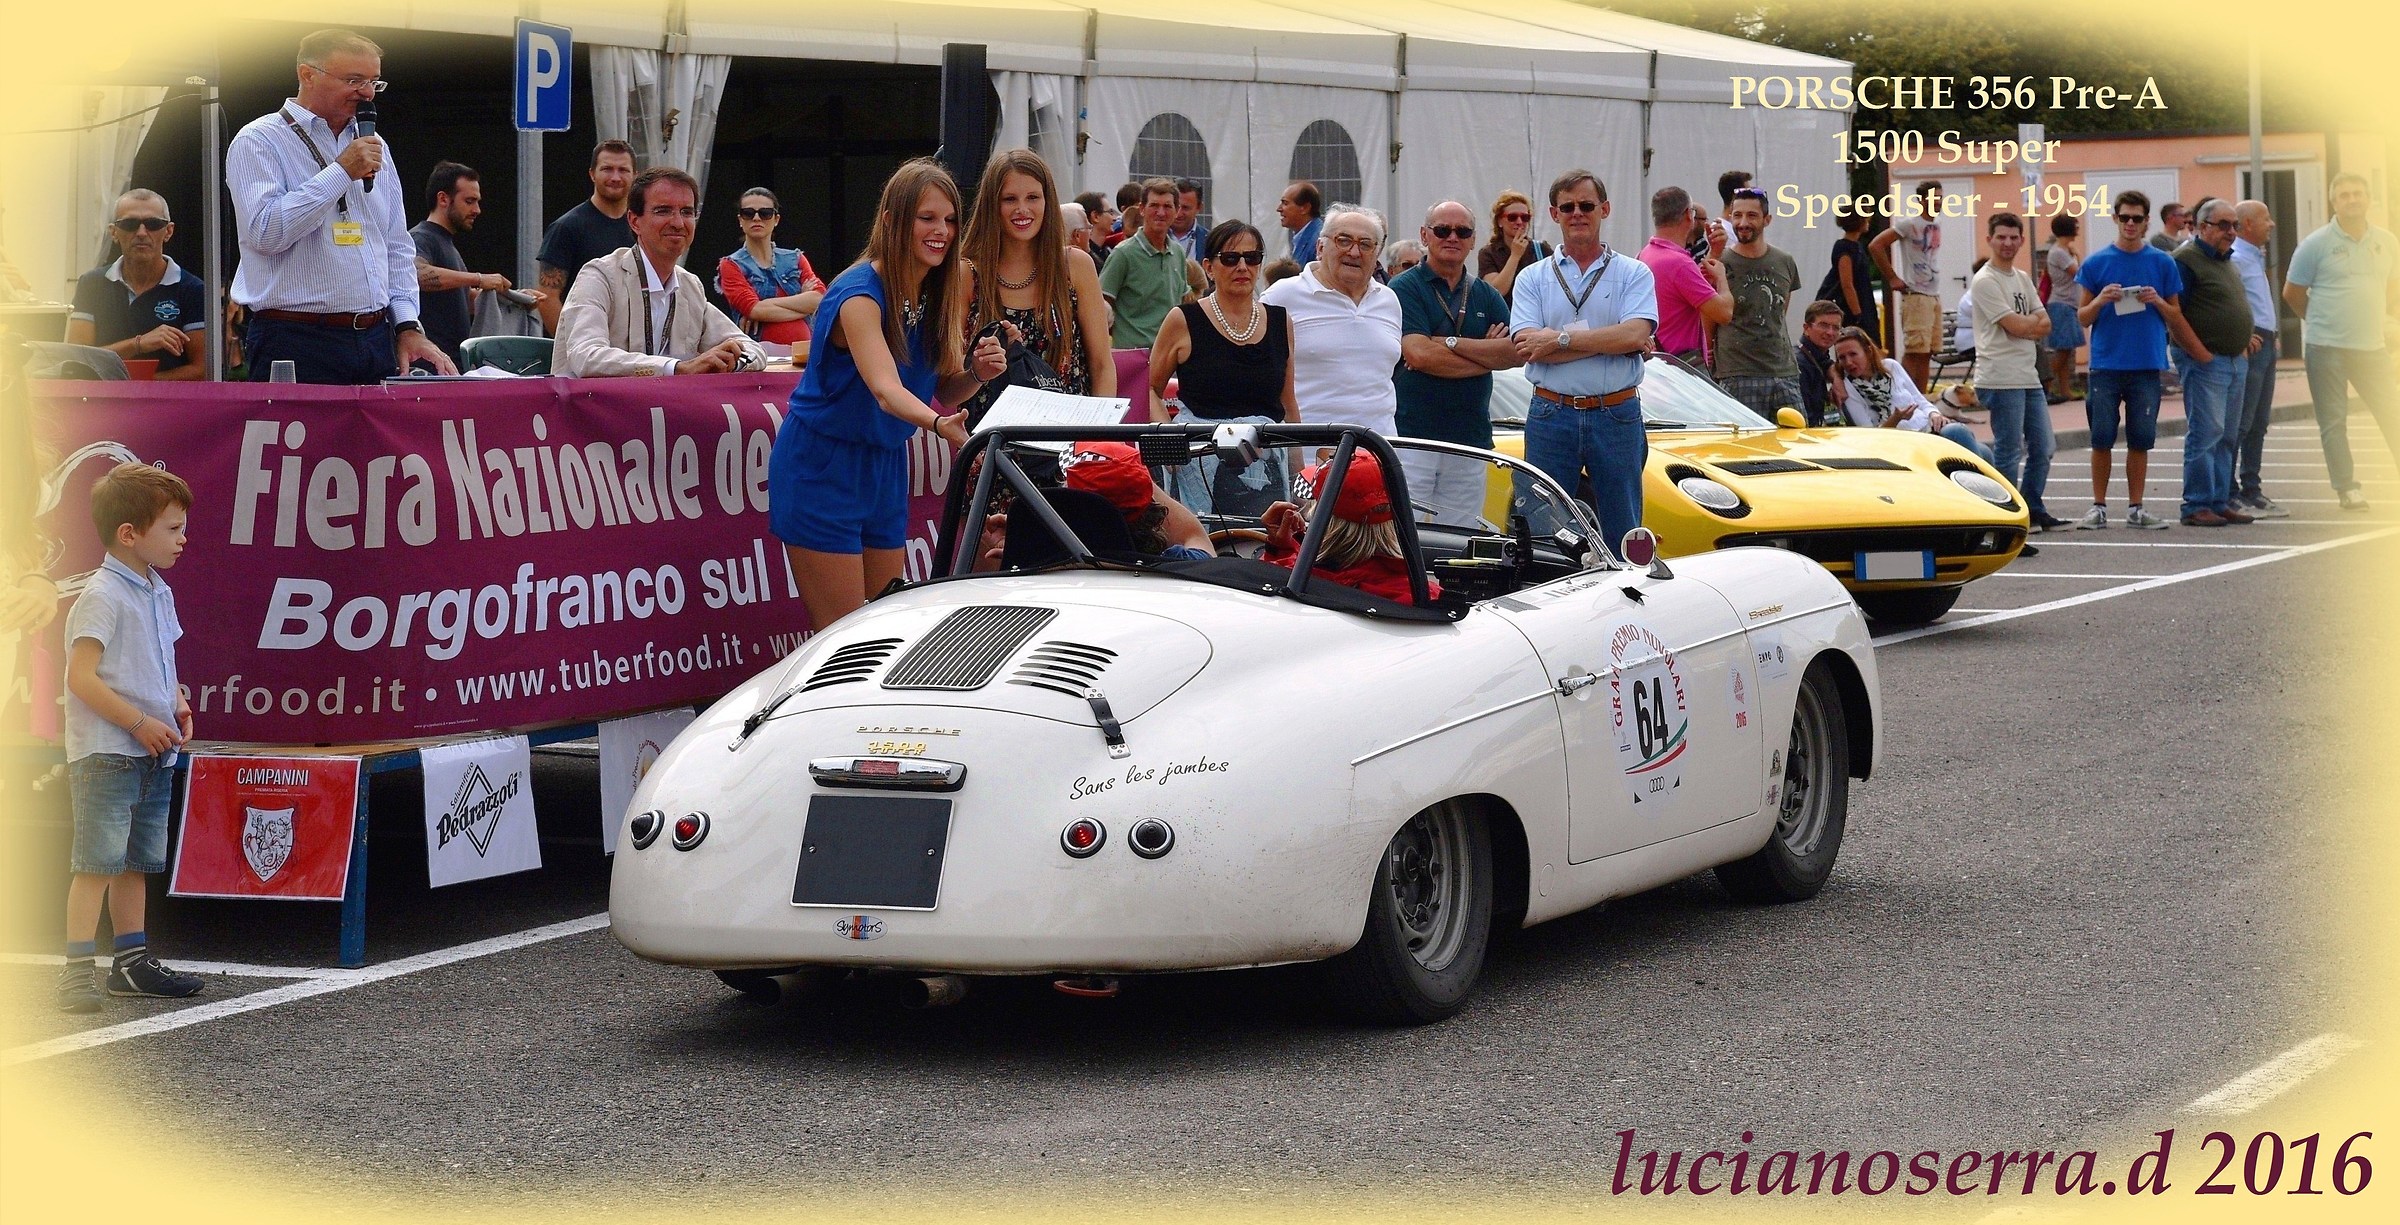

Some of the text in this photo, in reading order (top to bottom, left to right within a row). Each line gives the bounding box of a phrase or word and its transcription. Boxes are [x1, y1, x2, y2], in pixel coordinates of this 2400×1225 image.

[527, 31, 561, 122] P
[230, 420, 437, 551] Fiera
[442, 406, 703, 541] Nazionale
[257, 562, 686, 661] Borgofranco
[700, 538, 771, 610] sul
[456, 633, 744, 705] www.tuberfood.it
[1611, 624, 1640, 664] PREMIO
[857, 726, 962, 736] PORSCHE
[1633, 676, 1669, 760] 64
[237, 767, 309, 786] CAMPANINI
[436, 772, 518, 850] Pedrazzoli
[450, 762, 474, 809] Salumificio
[1069, 755, 1230, 801] Sans les jambes
